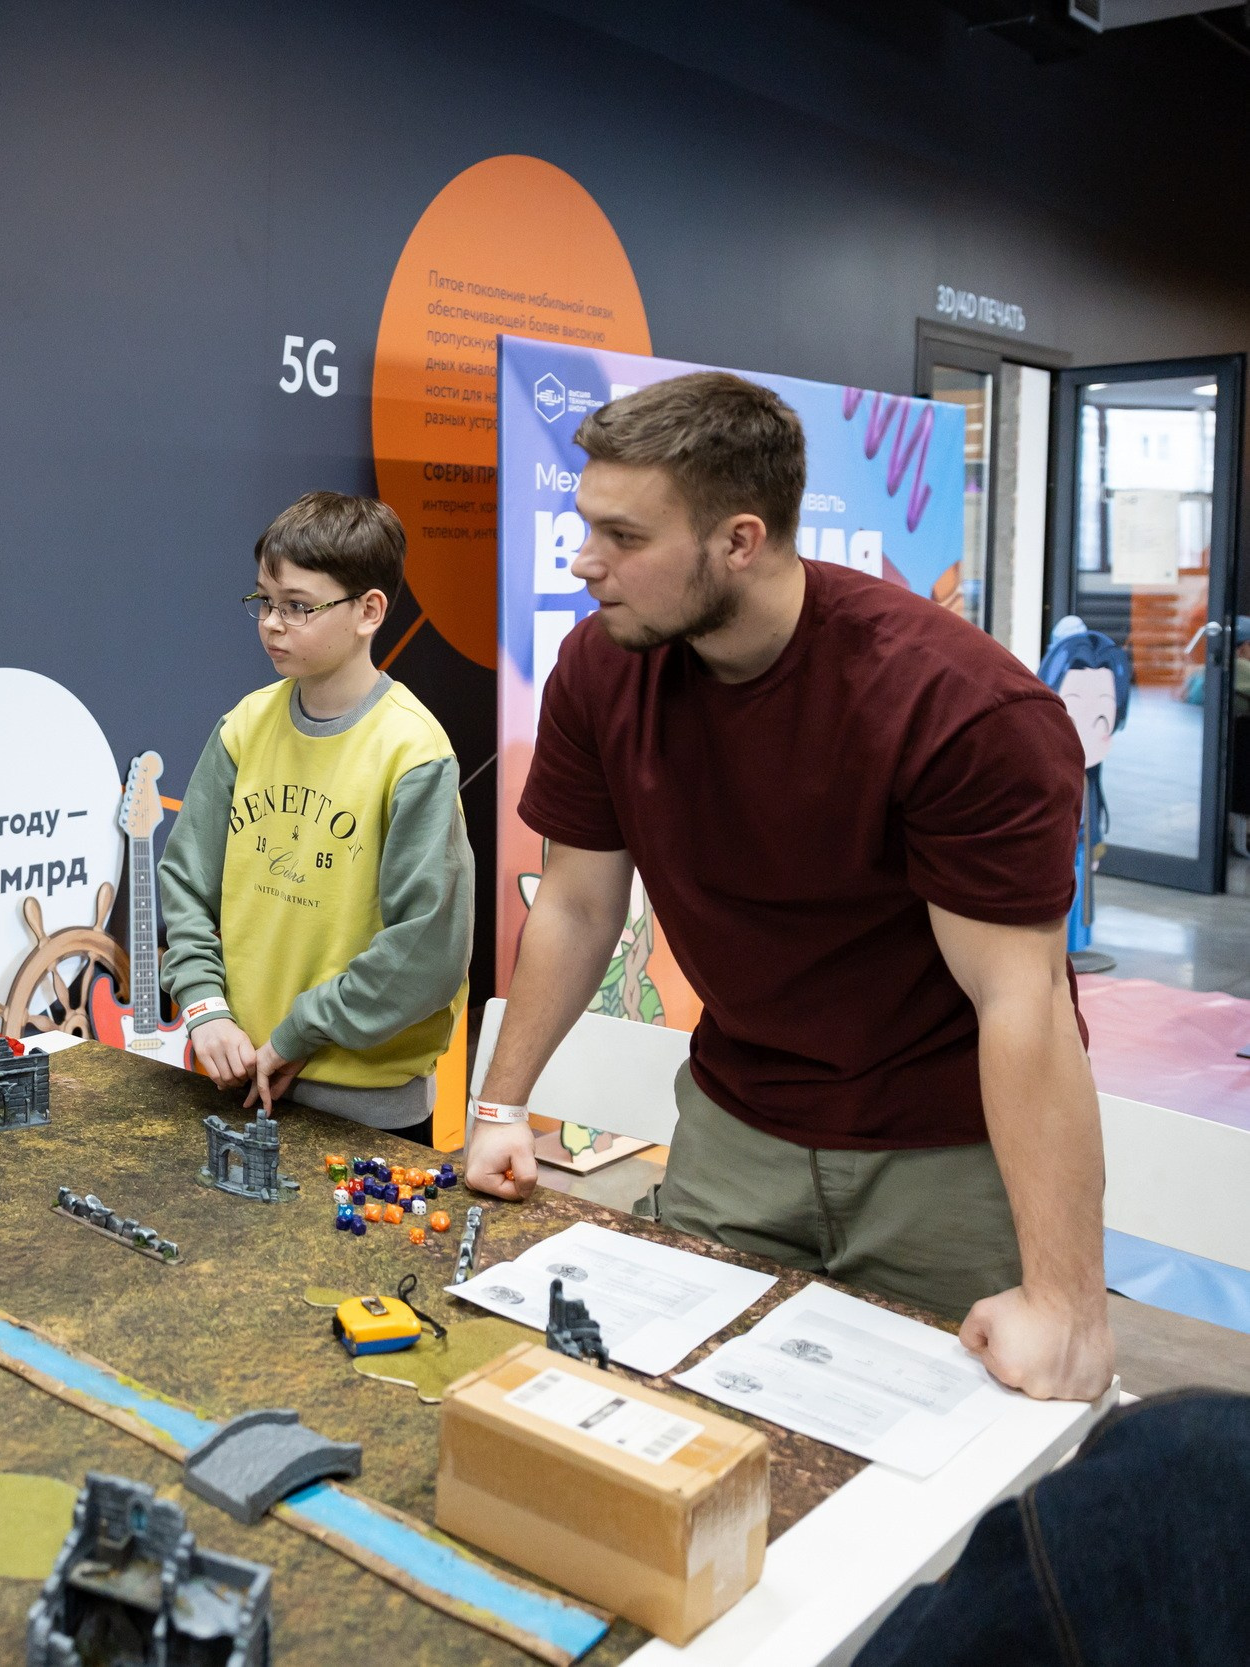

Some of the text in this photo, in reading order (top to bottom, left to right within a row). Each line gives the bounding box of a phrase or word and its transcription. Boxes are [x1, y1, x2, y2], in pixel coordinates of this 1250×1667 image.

[428, 270, 464, 293] Пятое
[467, 282, 526, 304] поколение
[528, 292, 583, 314] мобильной
[428, 299, 606, 345] обеспечивающей более высокую
[977, 295, 1026, 332] ПЕЧАТЬ
[279, 334, 339, 398] 5G
[425, 357, 456, 372] дных
[426, 385, 460, 399] ности
[462, 389, 483, 403] для
[425, 412, 466, 428] разных
[423, 462, 475, 484] СФЕРЫ
[255, 836, 334, 870] 19 65
[0, 857, 88, 897] млрд
